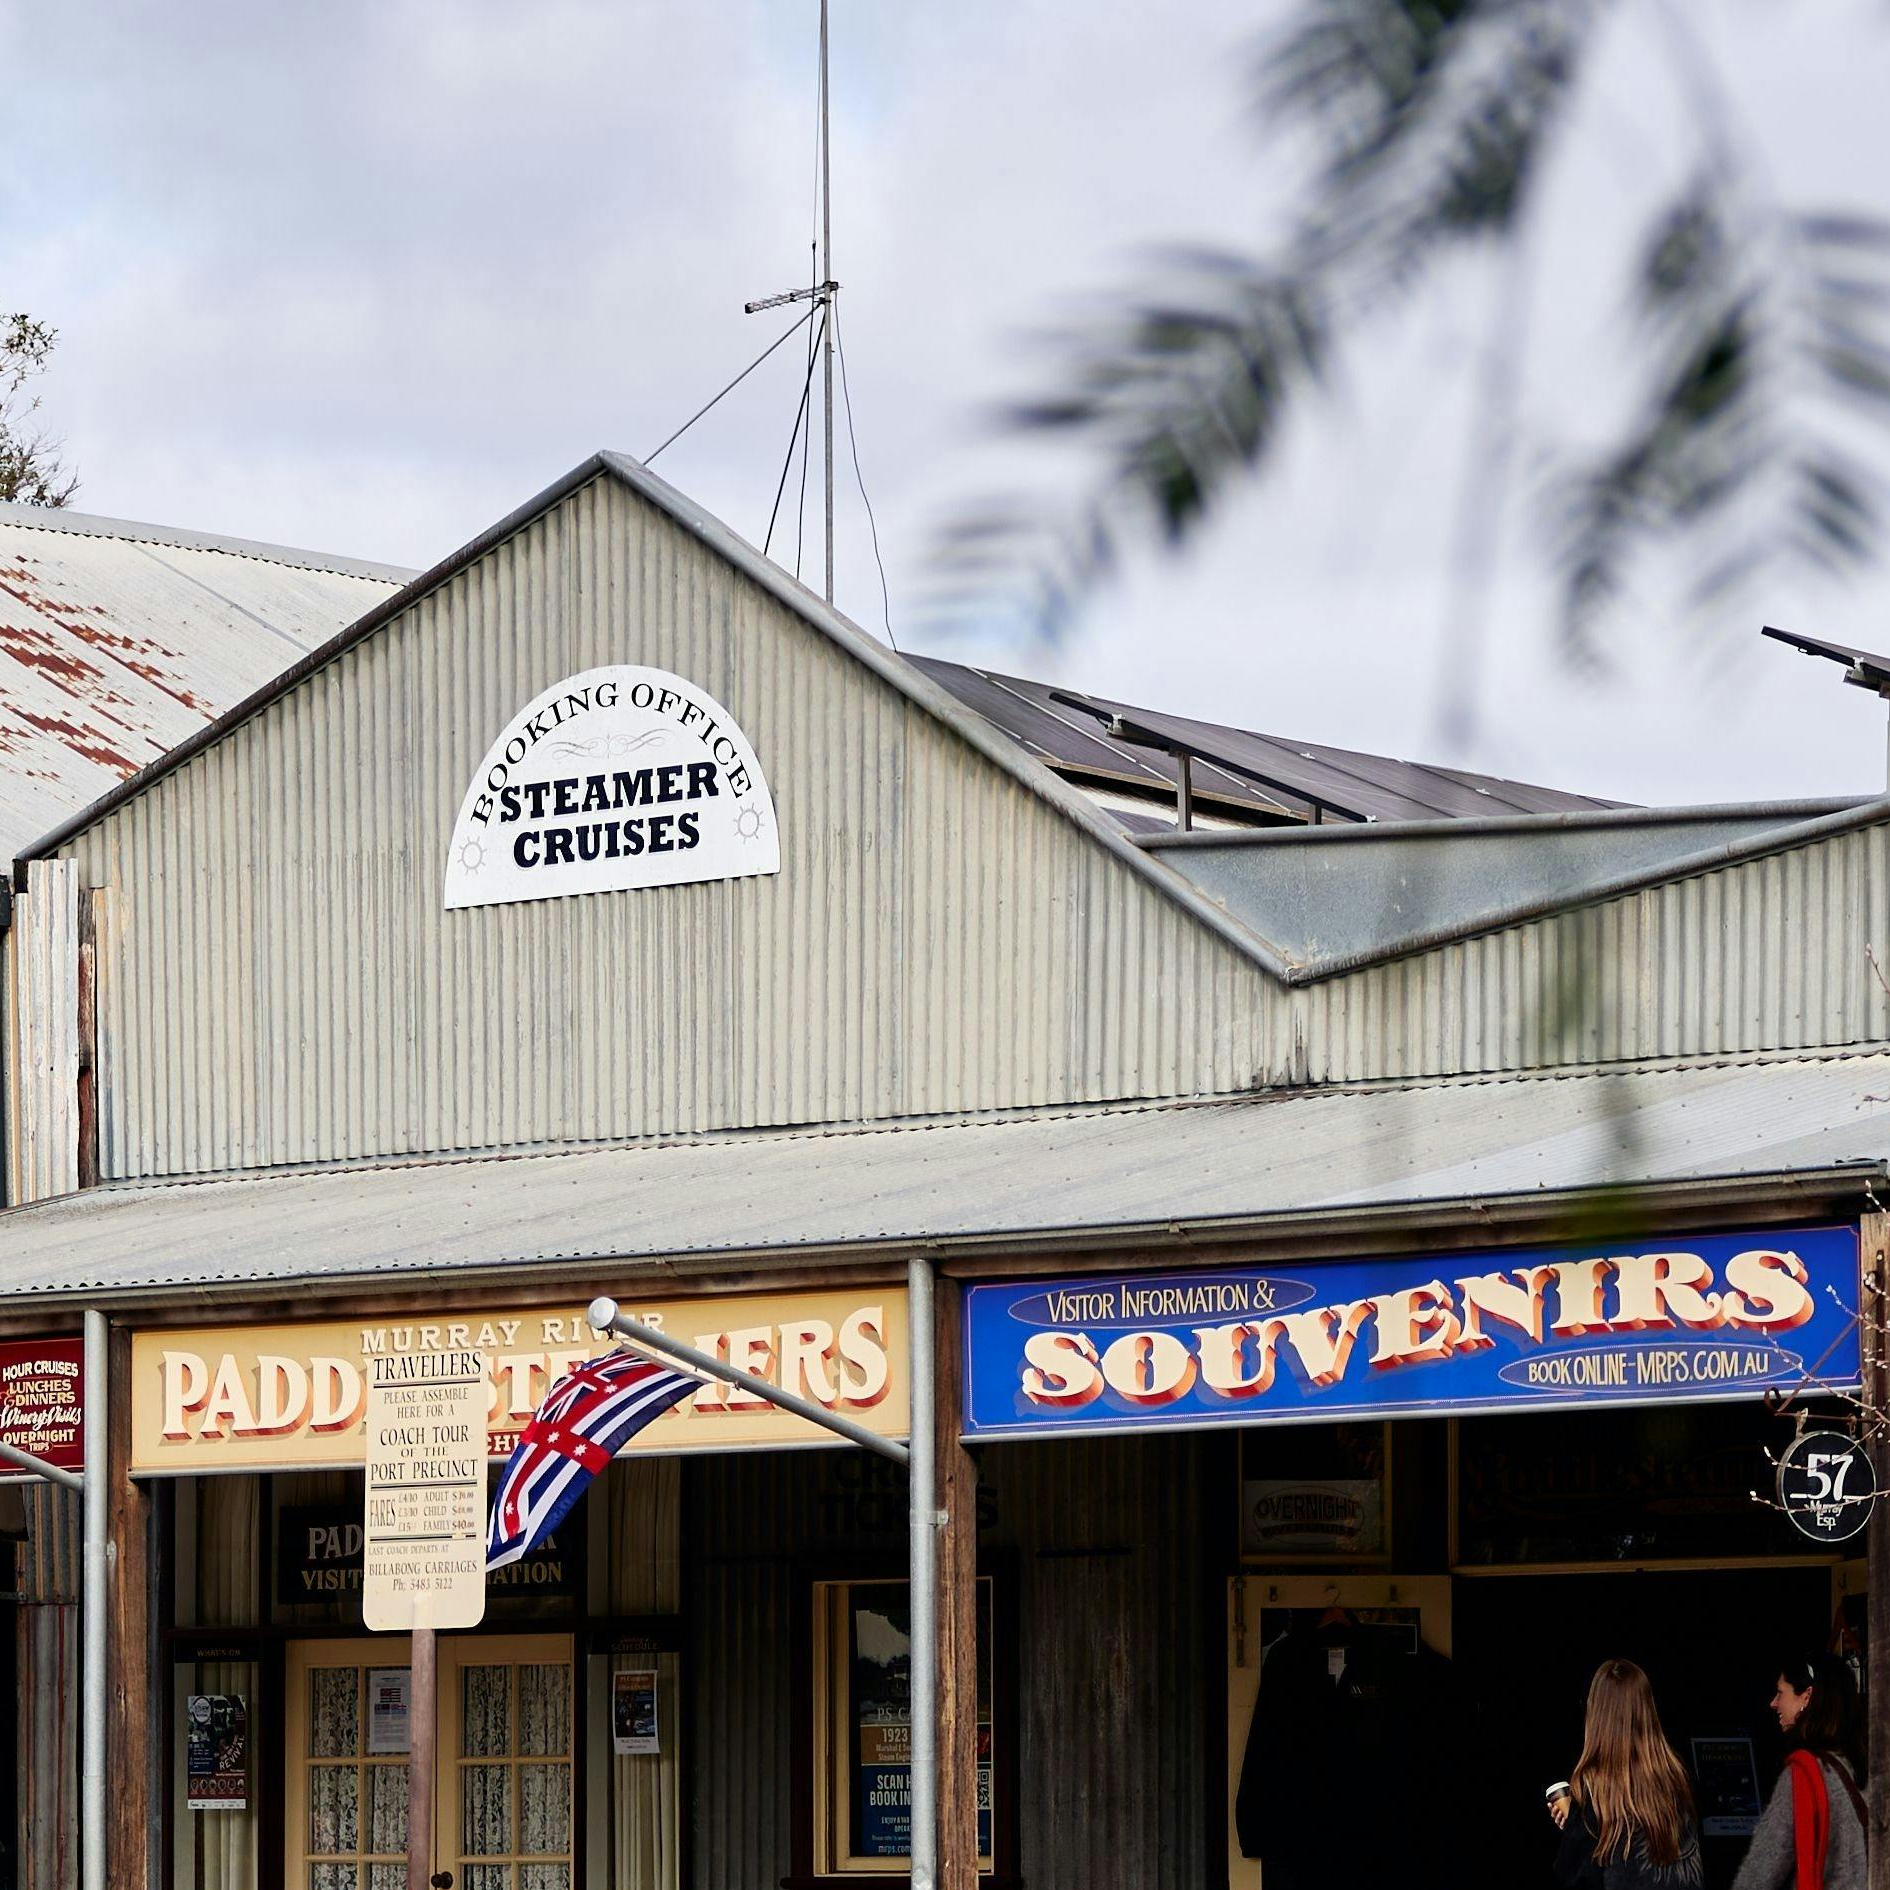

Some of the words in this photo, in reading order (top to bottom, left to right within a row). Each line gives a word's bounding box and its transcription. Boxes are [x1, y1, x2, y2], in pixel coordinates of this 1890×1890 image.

[470, 682, 619, 828] BOOKING
[631, 683, 753, 799] OFFICE
[499, 761, 720, 823] STEAMER
[513, 812, 700, 868] CRUISES
[1047, 1291, 1115, 1323] VISITOR
[1119, 1283, 1251, 1318] INFORMATION
[1253, 1287, 1275, 1310] &
[360, 1319, 519, 1355] MURRAY
[1019, 1250, 1816, 1408] SOUVENIRS
[2, 1362, 33, 1382] HOUR
[33, 1360, 79, 1377] CRUISES
[374, 1352, 482, 1380] TRAVELLERS
[1528, 1358, 1571, 1385] BOOK
[9, 1379, 72, 1395] LUNCHES
[384, 1390, 417, 1404] PLEASE
[422, 1387, 469, 1402] ASSEMBLE
[15, 1392, 76, 1407] DINNERS
[397, 1405, 422, 1419] HERE
[426, 1404, 444, 1417] FOR
[448, 1403, 455, 1416] A
[2, 1429, 76, 1445] OVERNIGHT
[380, 1427, 426, 1446] COACH
[433, 1424, 469, 1443] TOUR
[29, 1442, 50, 1452] TRIPS
[400, 1448, 415, 1458] OF
[424, 1446, 449, 1457] THE
[370, 1462, 406, 1481] PORT
[413, 1458, 478, 1479] PRECINCT
[1807, 1453, 1854, 1502] 57
[424, 1491, 450, 1502] ADULT
[369, 1499, 396, 1528] FARES
[423, 1505, 447, 1517] CHILD
[1258, 1495, 1357, 1521] OVERNIGHT
[423, 1520, 450, 1531] FAMILY
[368, 1547, 385, 1556] LAST
[386, 1545, 409, 1555] COACH
[410, 1545, 439, 1554] DEPARTS
[369, 1561, 421, 1576] BILLABONG
[425, 1560, 478, 1575] CARRIAGES
[882, 1728, 908, 1743] 1923
[877, 1774, 904, 1790] SCAN
[869, 1790, 898, 1806] BOOK
